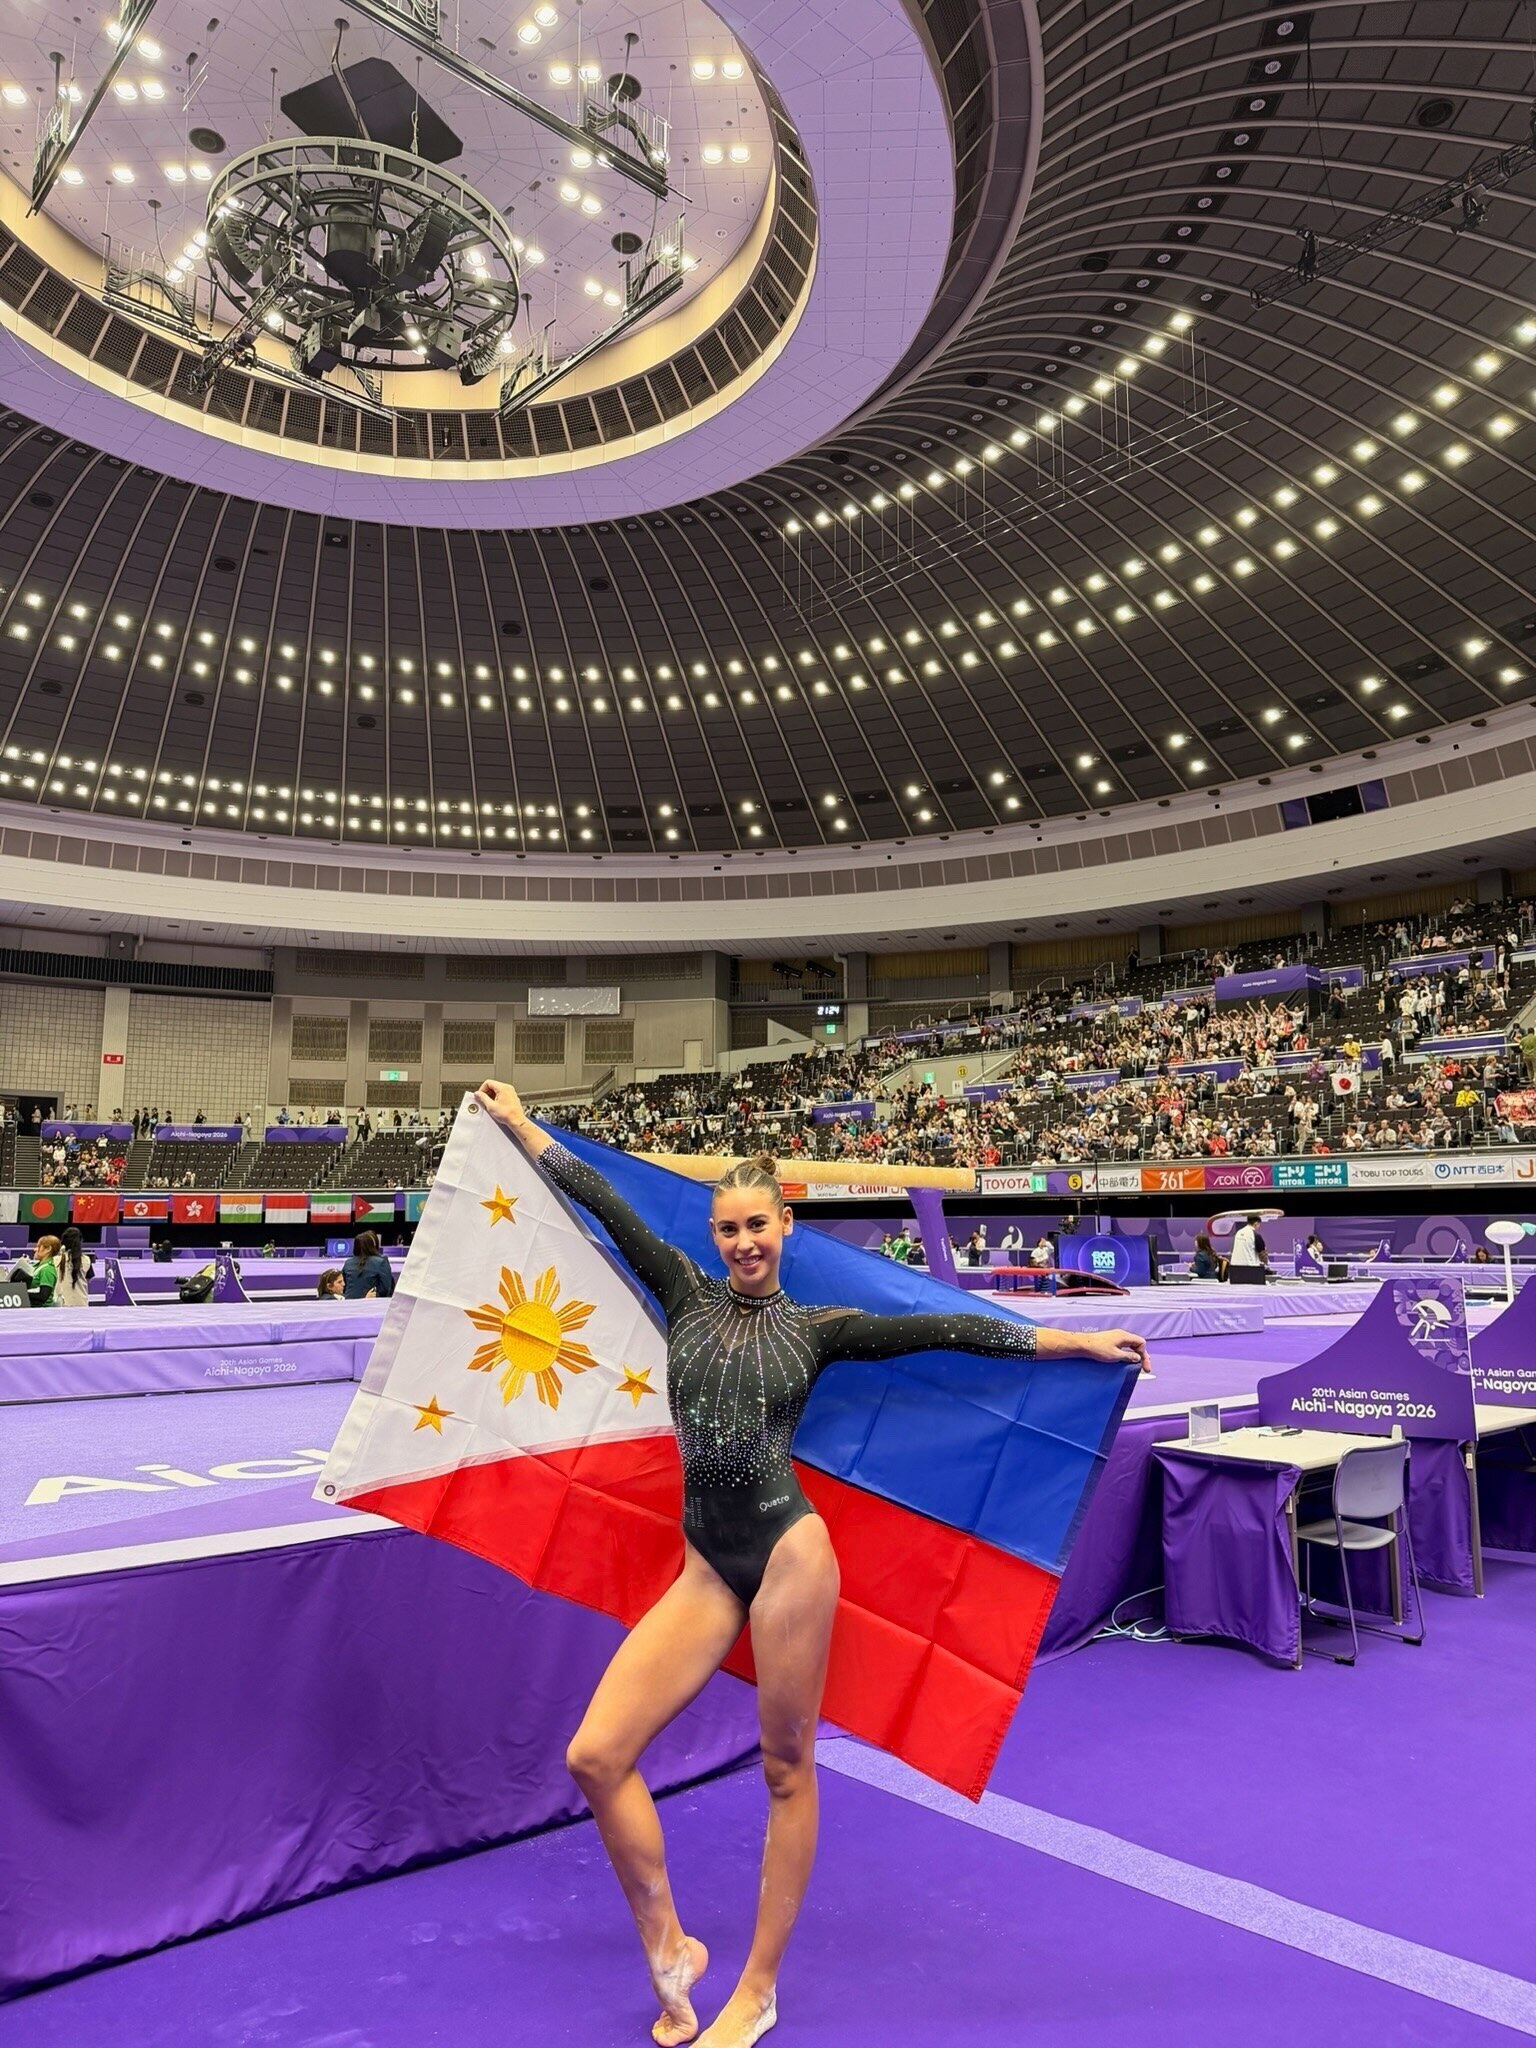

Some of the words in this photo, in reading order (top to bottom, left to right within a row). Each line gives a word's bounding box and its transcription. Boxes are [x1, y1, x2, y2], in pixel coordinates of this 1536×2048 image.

[1279, 1165, 1305, 1178] ニトリ
[1314, 1164, 1342, 1177] ニトリ
[1359, 1170, 1380, 1178] TOBU
[1382, 1169, 1397, 1177] TOP
[1398, 1168, 1424, 1176] TOURS
[1453, 1165, 1476, 1175] NTT
[984, 1178, 1031, 1190] TOYOTA
[1072, 1178, 1078, 1188] 5
[1099, 1176, 1139, 1188] 中部電力
[1279, 1178, 1306, 1186] NITORI
[1314, 1177, 1342, 1185] NITORI
[848, 1185, 888, 1195] Canon
[220, 1358, 236, 1367] 20th
[238, 1358, 257, 1366] Asian
[258, 1357, 283, 1365] Games
[204, 1364, 271, 1377] Aichi-Nagoya
[273, 1362, 297, 1373] 2026
[1487, 1367, 1515, 1378] Asian
[1471, 1376, 1536, 1395] i-Nagoya
[1311, 1387, 1336, 1398] 20th
[1339, 1388, 1368, 1400] Asian
[1370, 1389, 1410, 1401] Games
[1291, 1397, 1393, 1420] Aichi-Nagoya
[1396, 1403, 1437, 1419] 2026
[759, 1495, 790, 1513] Quatro
